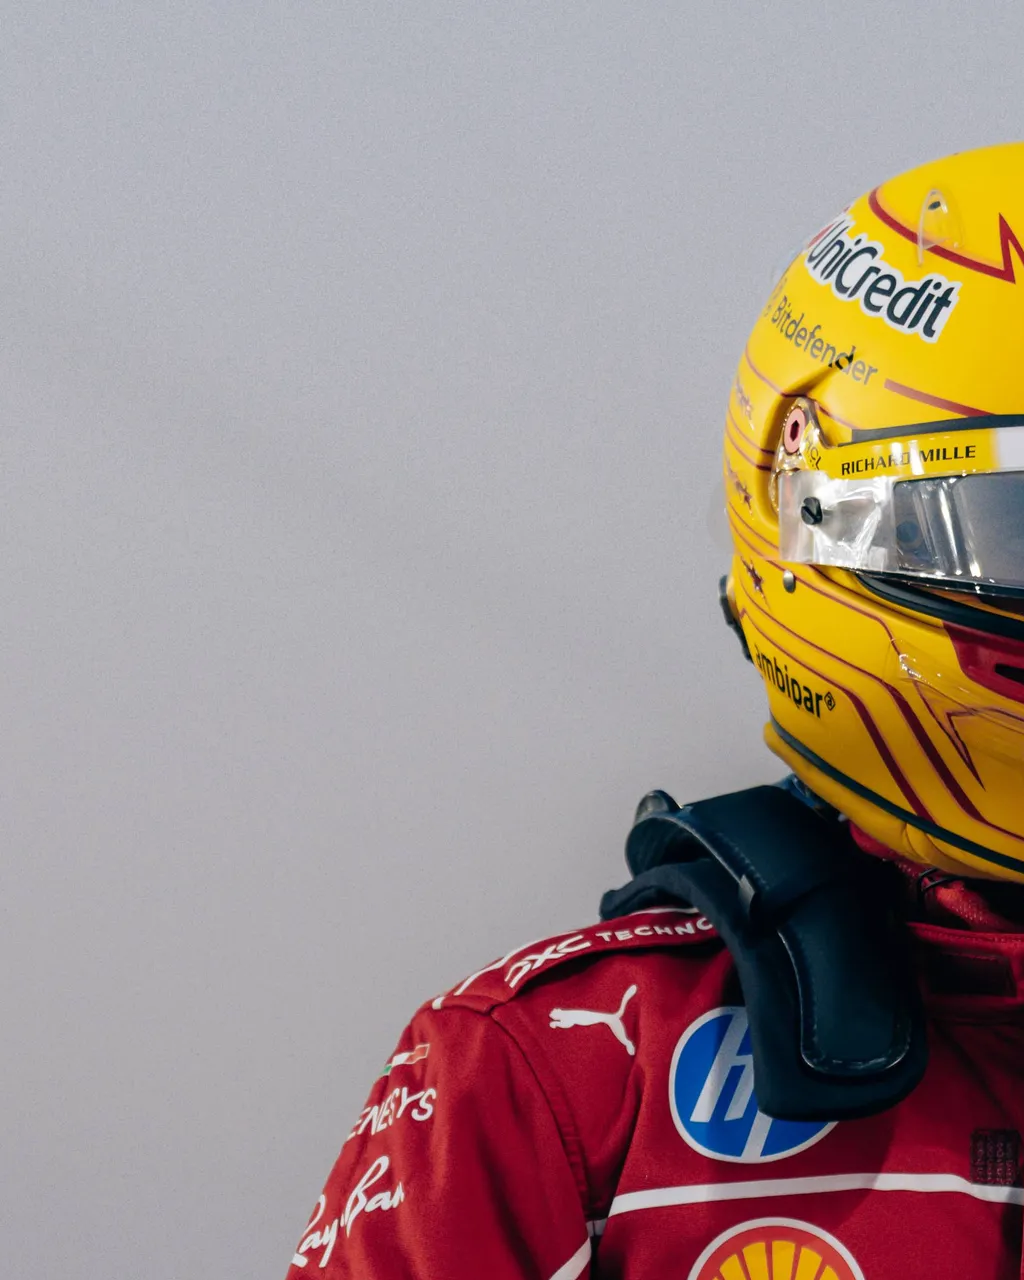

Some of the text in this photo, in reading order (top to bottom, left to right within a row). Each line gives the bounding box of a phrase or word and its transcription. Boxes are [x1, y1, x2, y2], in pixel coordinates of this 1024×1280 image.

[807, 219, 952, 338] UniCredit
[771, 295, 878, 385] Bitdefender
[841, 451, 910, 476] RICHARD
[920, 445, 976, 462] MILLE
